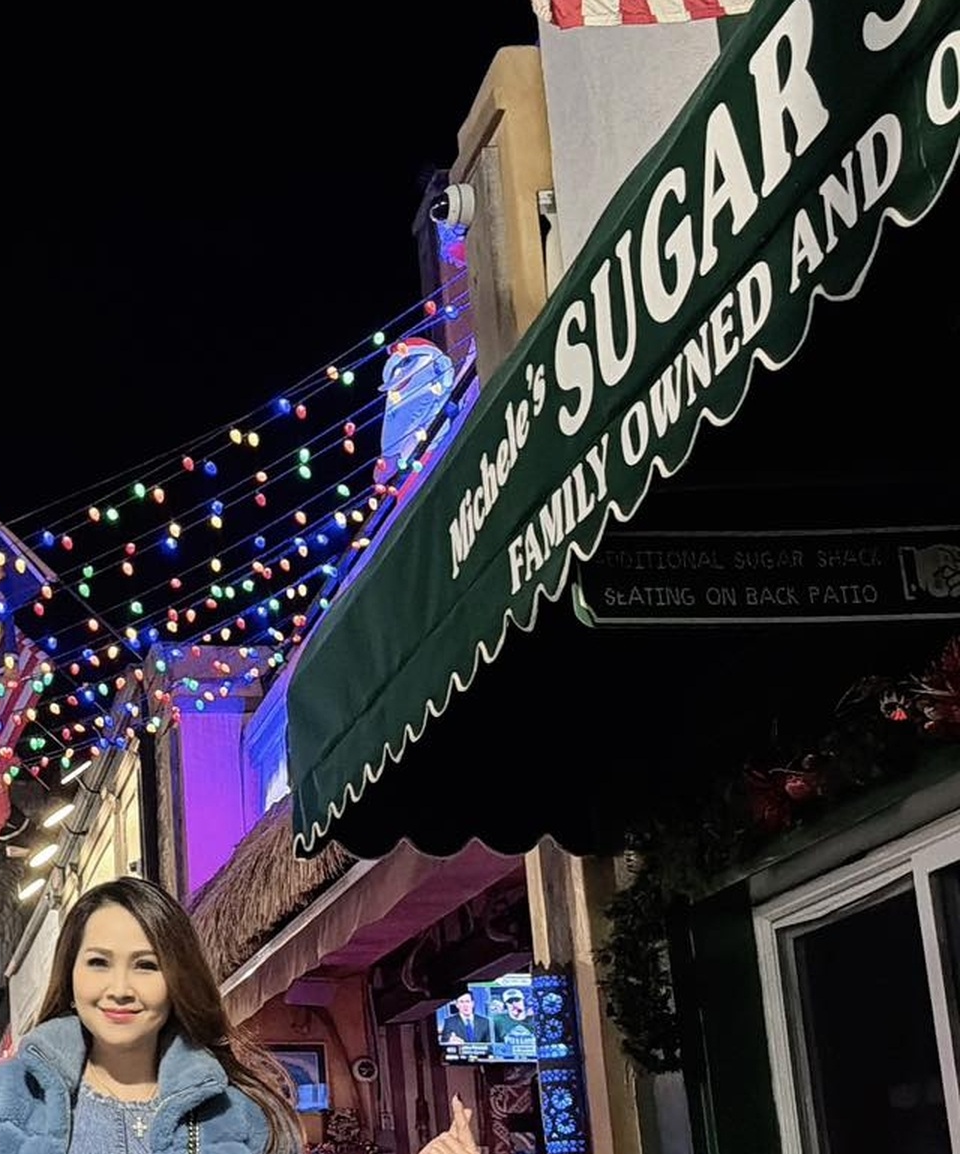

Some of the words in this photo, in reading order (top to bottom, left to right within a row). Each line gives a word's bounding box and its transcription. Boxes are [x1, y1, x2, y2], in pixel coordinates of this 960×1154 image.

[448, 363, 546, 580] Michele's
[554, 0, 830, 437] SUGAR
[507, 432, 610, 596] FAMILY
[620, 260, 774, 467] OWNED
[789, 113, 903, 294] AND
[596, 549, 725, 570] DDITIONAL
[733, 549, 805, 570] SUGAR
[603, 586, 697, 607] SEATING
[705, 586, 739, 606] ON
[745, 585, 800, 606] BACK
[808, 583, 879, 605] PATIO
